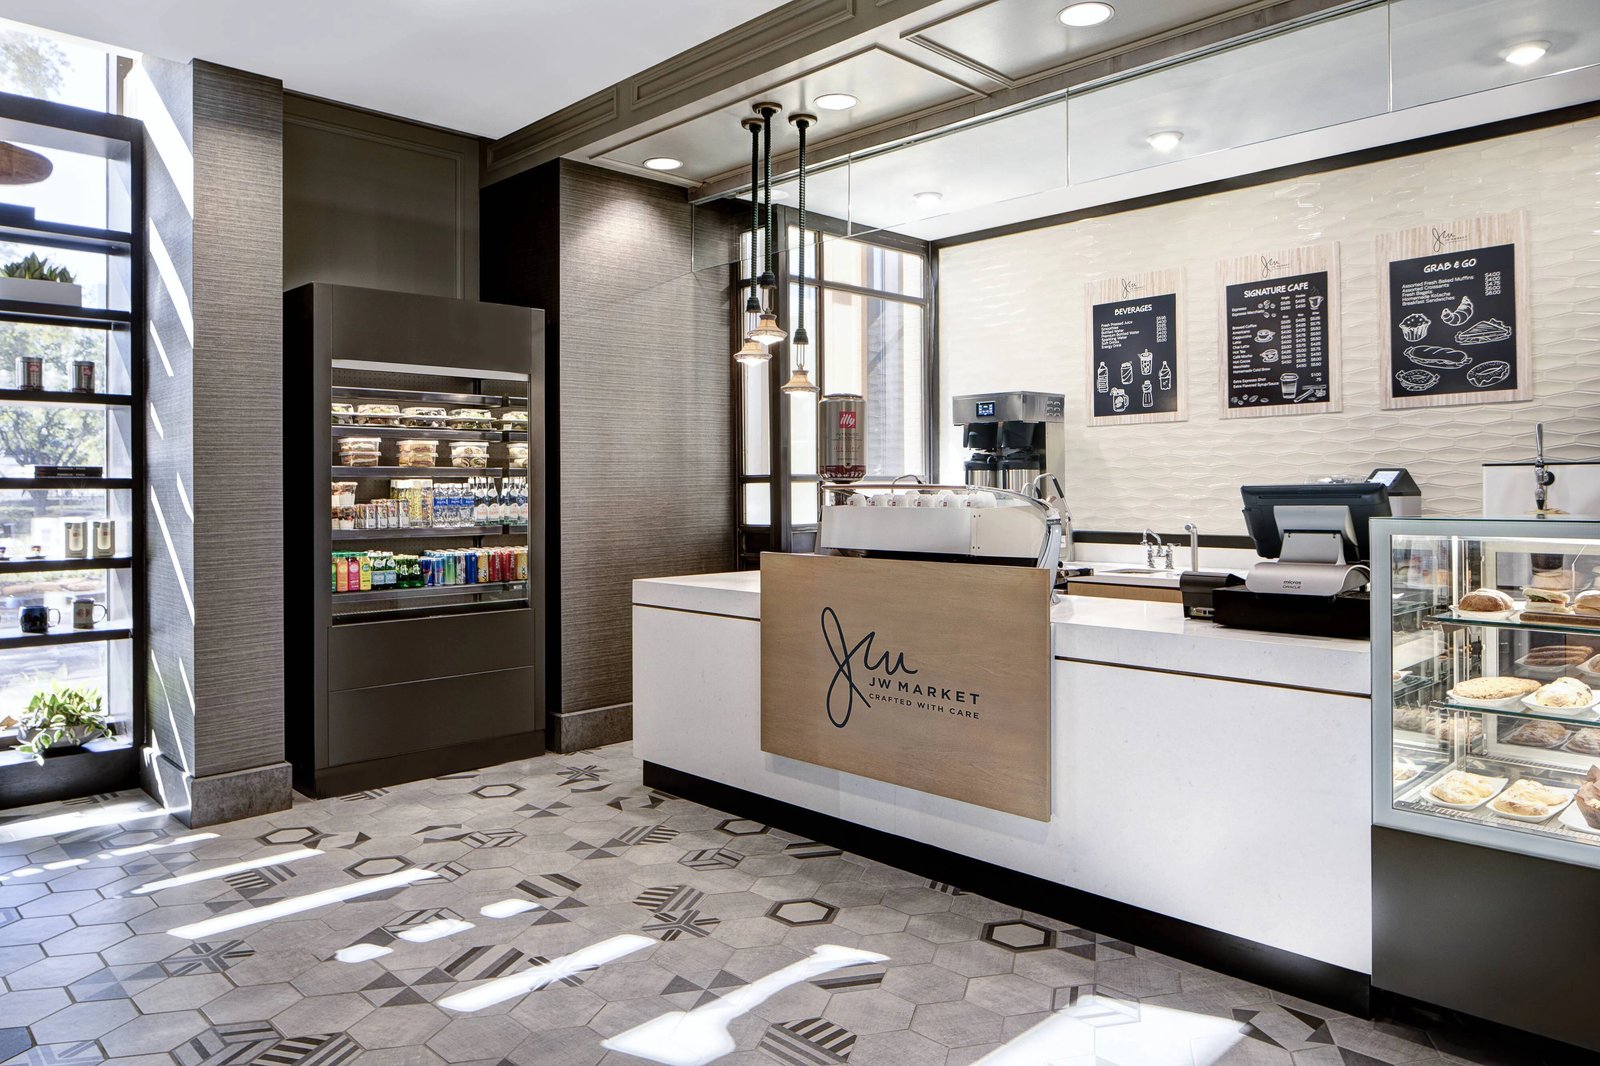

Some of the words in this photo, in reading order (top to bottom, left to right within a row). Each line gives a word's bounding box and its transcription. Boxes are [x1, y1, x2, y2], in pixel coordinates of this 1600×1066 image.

[1424, 262, 1452, 273] GRAB
[1461, 258, 1476, 268] GO
[1244, 285, 1286, 298] SIGNATURE
[1287, 282, 1309, 292] CAFE
[1114, 304, 1152, 316] BEVERAGES
[840, 414, 856, 428] illy
[869, 676, 891, 690] JW
[898, 681, 980, 705] MARKET
[869, 693, 912, 706] CRAFTED
[917, 702, 944, 712] WITH
[949, 708, 980, 720] CARE
